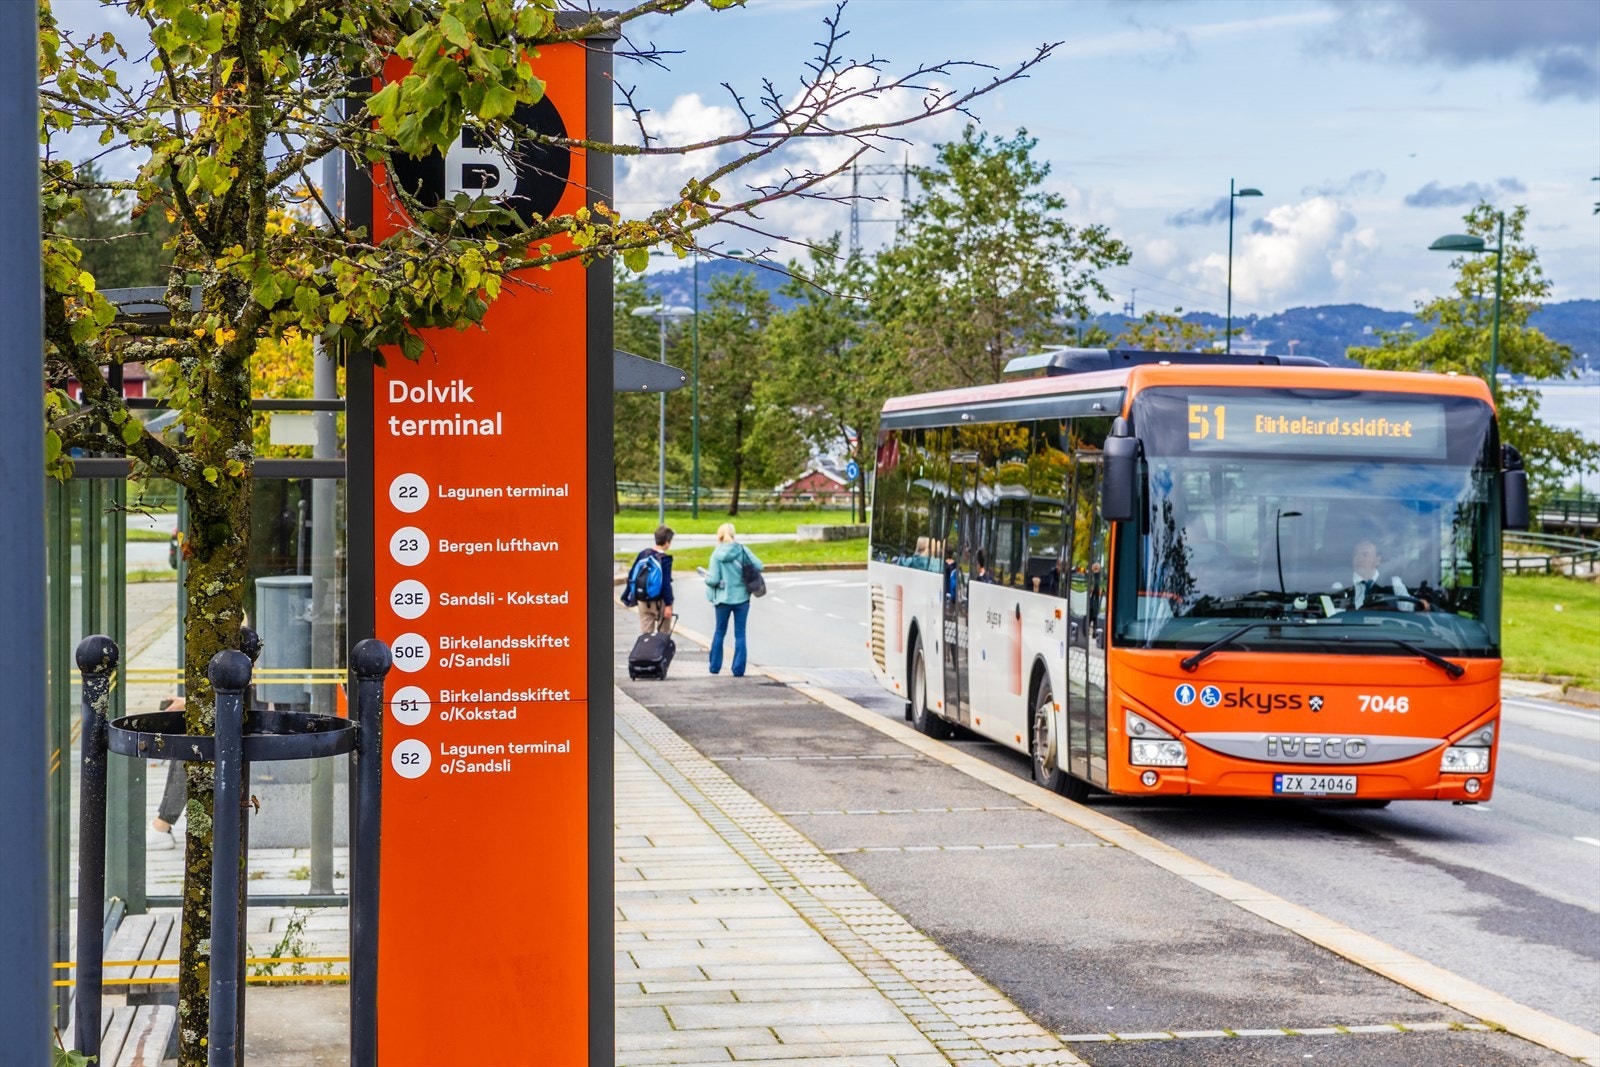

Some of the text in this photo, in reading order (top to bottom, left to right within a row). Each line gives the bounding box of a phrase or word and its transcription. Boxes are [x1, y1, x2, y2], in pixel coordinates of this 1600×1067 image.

[445, 108, 518, 205] B
[389, 379, 474, 403] Dolvik
[388, 412, 502, 436] terminal
[1188, 405, 1225, 440] 51
[398, 486, 418, 498] 22
[438, 484, 569, 501] Lagunen terminal
[399, 539, 419, 551] 23
[438, 538, 559, 555] Bergen lufthavn
[394, 593, 424, 605] 23E
[439, 592, 495, 606] Sandsli
[507, 591, 569, 605] Kokstad
[439, 634, 570, 650] Birkelandsskiftet
[394, 646, 424, 658] 50E
[439, 653, 510, 668] o/Sandsli
[440, 688, 570, 703] Birkelandsskiftet
[1223, 687, 1302, 714] skyss
[400, 699, 419, 711] 51
[1358, 695, 1409, 713] 7046
[440, 706, 517, 721] o/Kokstad
[440, 740, 570, 758] Lagunen terminal
[1267, 736, 1368, 759] IVECO
[400, 752, 420, 765] 52
[440, 759, 511, 774] o/Sandsli
[1286, 777, 1303, 790] ZX
[1310, 777, 1353, 791] 24046
